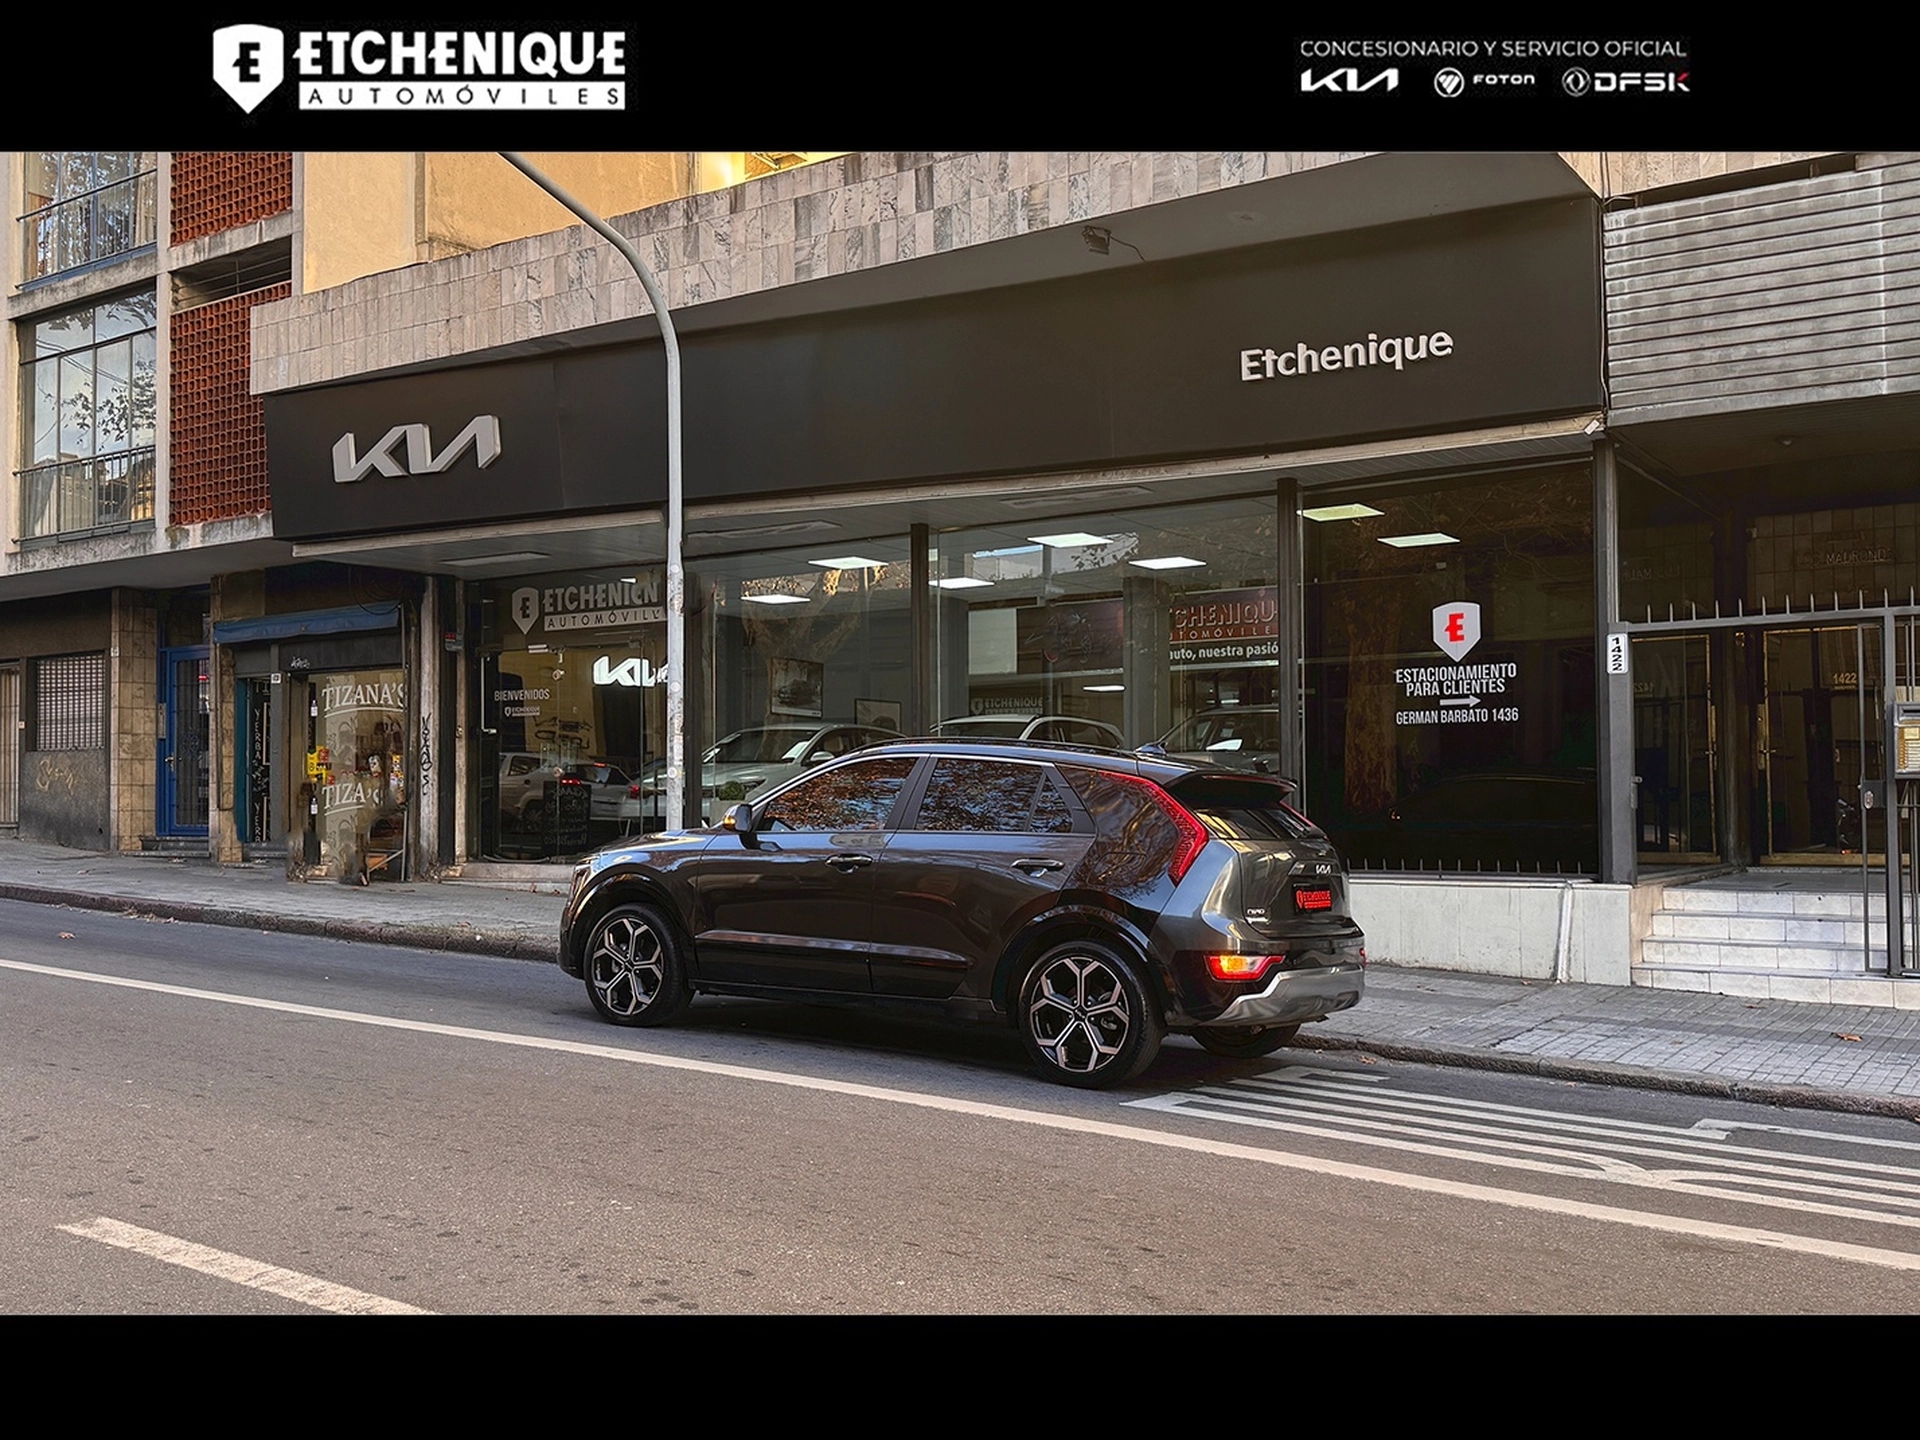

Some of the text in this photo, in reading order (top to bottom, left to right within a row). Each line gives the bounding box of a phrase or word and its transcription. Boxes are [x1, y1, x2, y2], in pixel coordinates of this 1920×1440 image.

[1240, 330, 1454, 382] Etchenique
[332, 414, 502, 483] KIA
[1199, 644, 1244, 659] nuestra
[1611, 636, 1623, 671] 1422
[1395, 663, 1517, 684] ESTACIONAMIENTO
[1832, 672, 1858, 685] 1422
[494, 688, 551, 701] BIENVENIDOS
[1406, 678, 1506, 697] PARA CLIENTES
[1396, 707, 1519, 725] GERMAN BARBATO 1436
